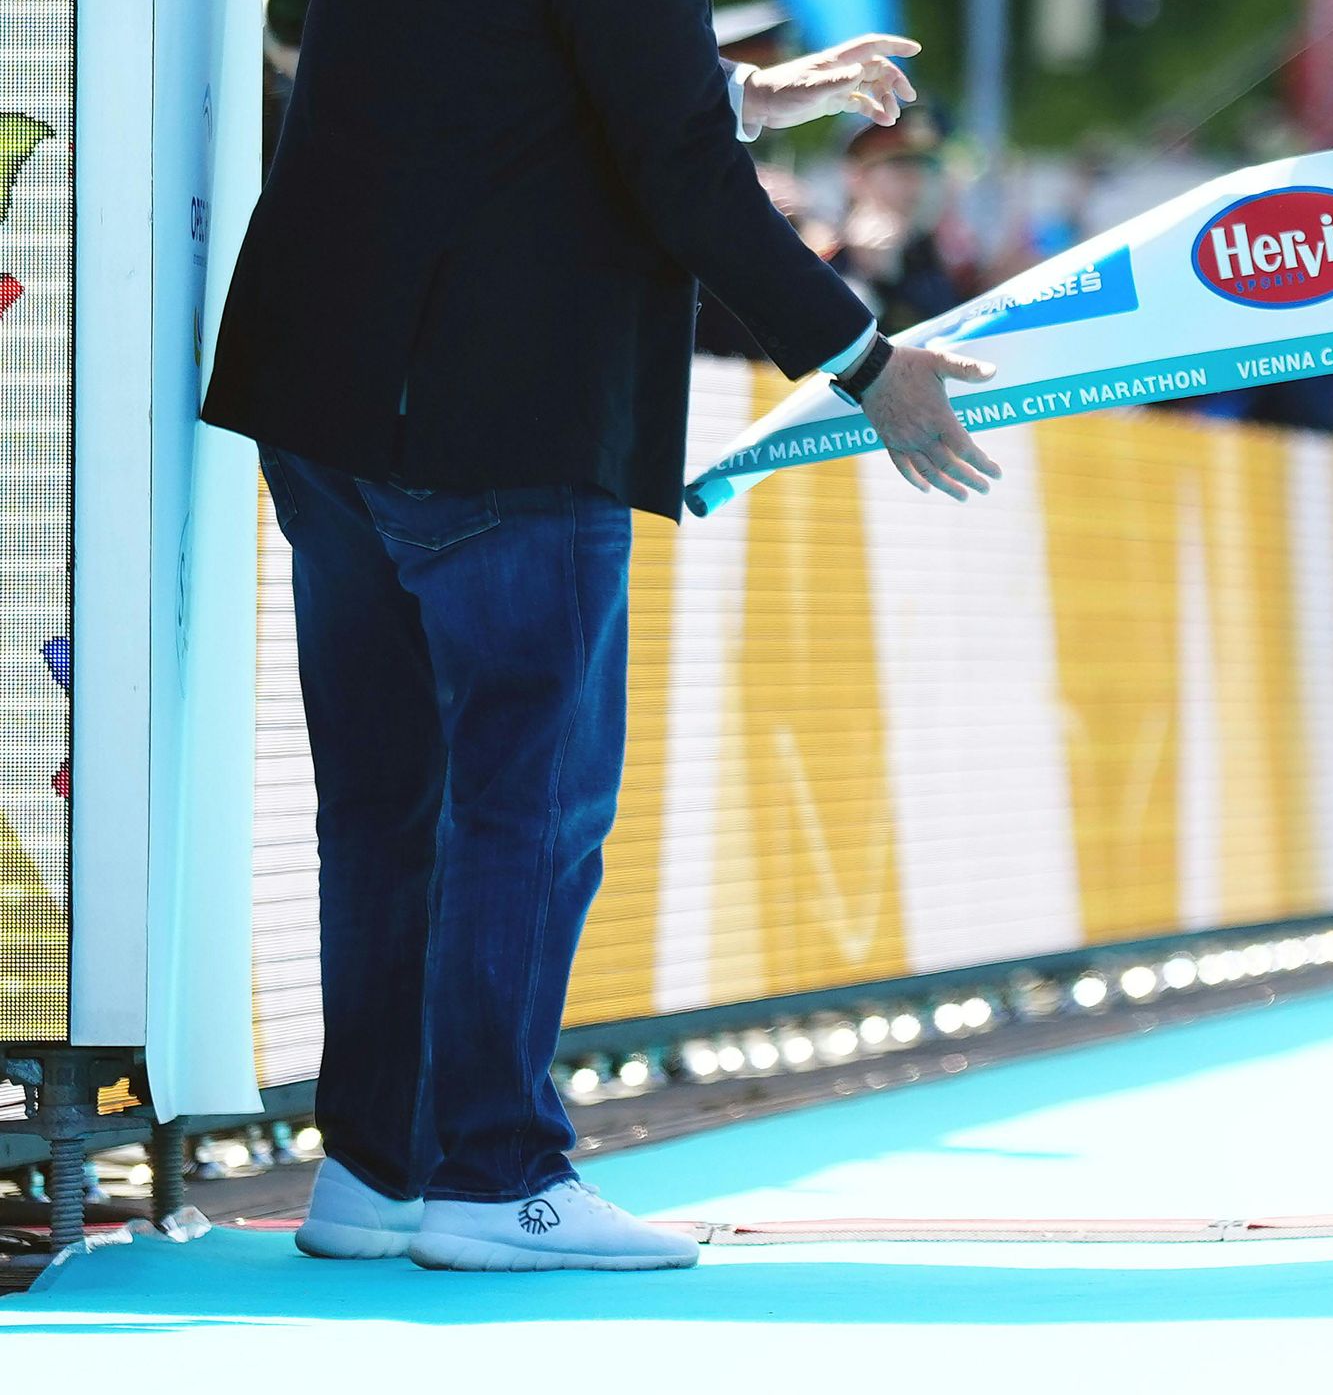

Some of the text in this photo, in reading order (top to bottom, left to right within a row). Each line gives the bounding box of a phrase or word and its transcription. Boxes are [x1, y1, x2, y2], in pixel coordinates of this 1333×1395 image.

[1235, 272, 1306, 293] SPORTS
[1236, 352, 1315, 380] VIENNA
[957, 368, 1206, 429] ENNA CITY MARATHON
[716, 427, 879, 472] CITY MARATHO
